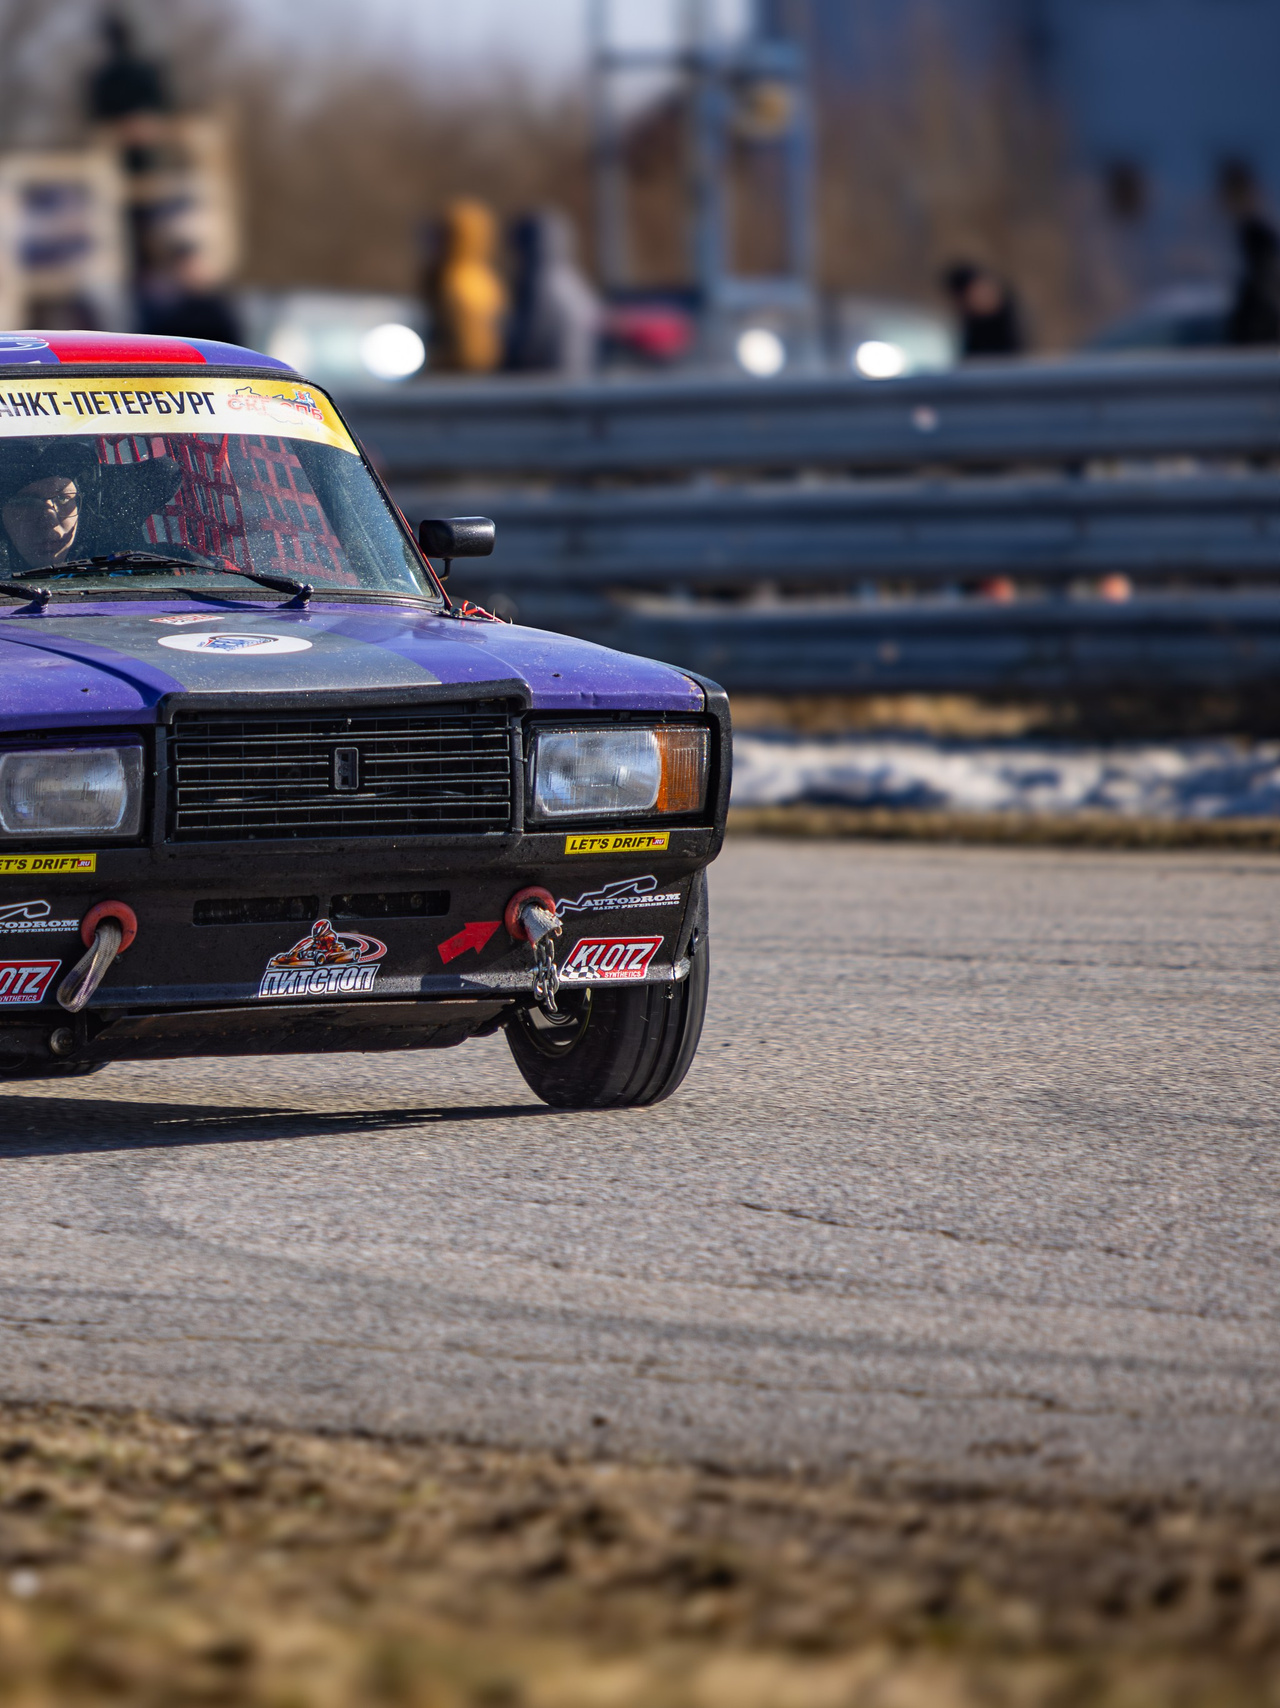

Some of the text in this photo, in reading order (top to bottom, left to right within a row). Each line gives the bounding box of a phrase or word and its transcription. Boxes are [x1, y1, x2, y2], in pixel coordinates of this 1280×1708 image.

[570, 838, 609, 850] LET'S
[582, 892, 681, 907] AUTODROM
[573, 943, 654, 971] KLOTZ
[260, 966, 377, 996] ПИТСТОП
